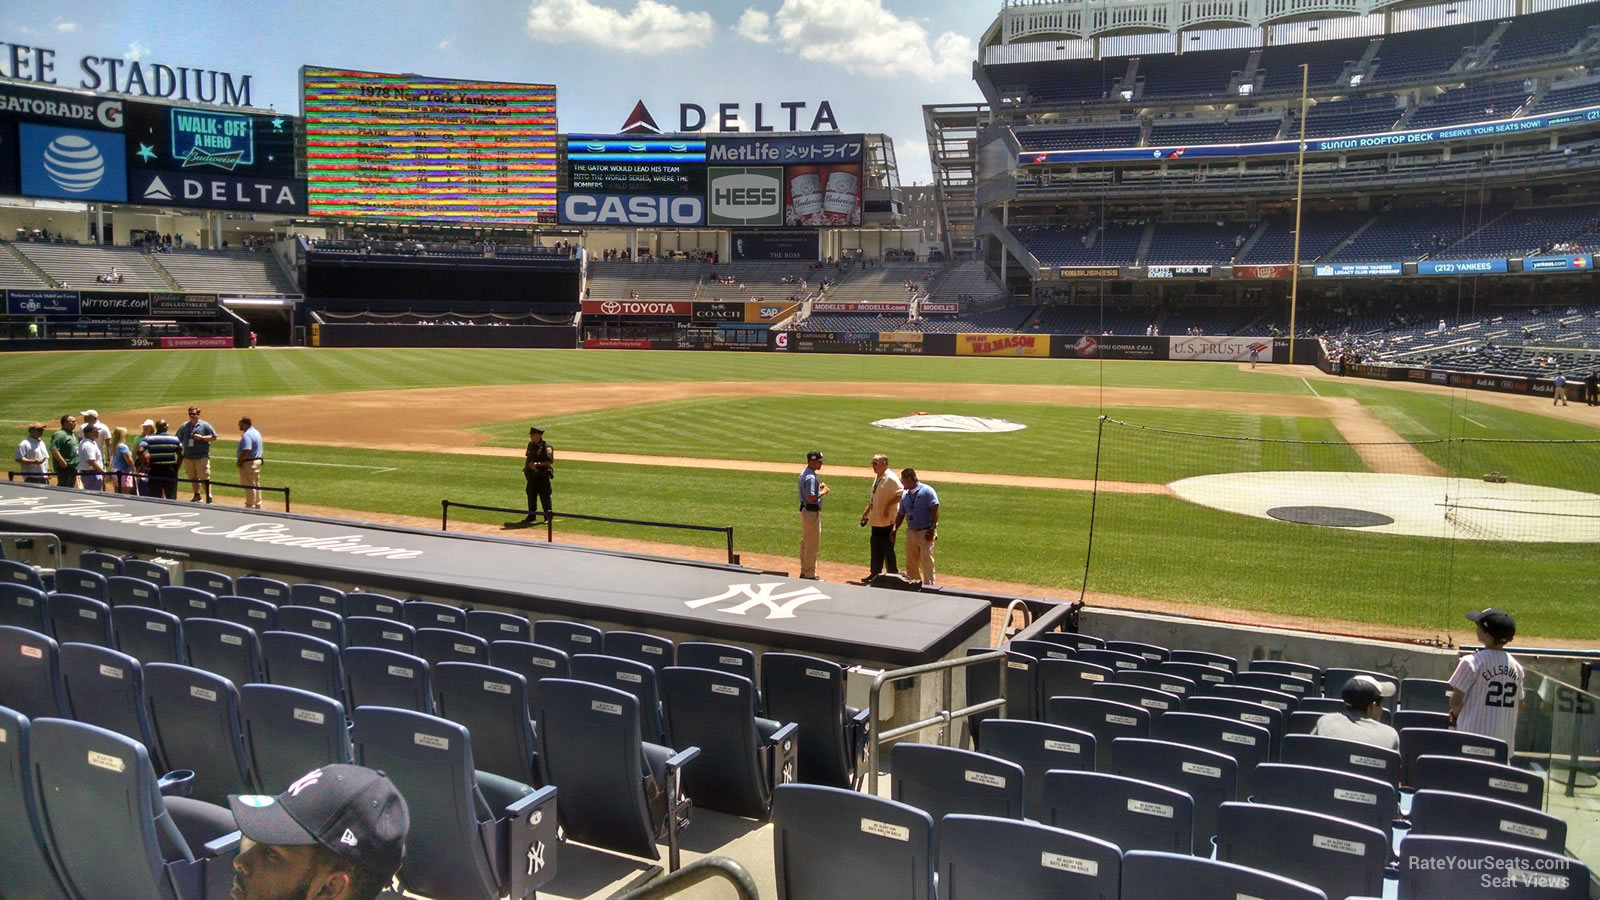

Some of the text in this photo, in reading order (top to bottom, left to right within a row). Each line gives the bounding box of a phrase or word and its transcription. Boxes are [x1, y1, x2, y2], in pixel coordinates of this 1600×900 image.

[80, 55, 253, 107] STADIUM
[359, 85, 508, 107] 1978 New York Yankees
[0, 95, 94, 121] GATORADE
[680, 100, 839, 132] DELTA
[1439, 120, 1541, 139] RESERVE YOUR SEATS NOW!
[195, 134, 232, 149] A HERO
[1360, 135, 1406, 147] ROOFTOP
[1408, 132, 1434, 142] DECK
[182, 150, 243, 164] Budweiser
[709, 142, 862, 161] MetLife メットライフ
[183, 179, 296, 205] DELTA
[715, 188, 777, 206] HESS
[565, 195, 702, 224] CASIO
[1434, 262, 1492, 273] (212) YANKEES
[623, 302, 675, 314] TOYOTA
[760, 308, 778, 317] SAP
[815, 303, 906, 312] MODELL'S MODELLS.com
[923, 304, 955, 312] MODELL'S
[1174, 343, 1243, 355] U.S. TRUST
[1477, 378, 1495, 387] Audi A4
[1532, 383, 1554, 393] Audi A4
[191, 522, 423, 559] Stadium
[1485, 681, 1518, 708] 22
[1077, 864, 1089, 872] BALLS
